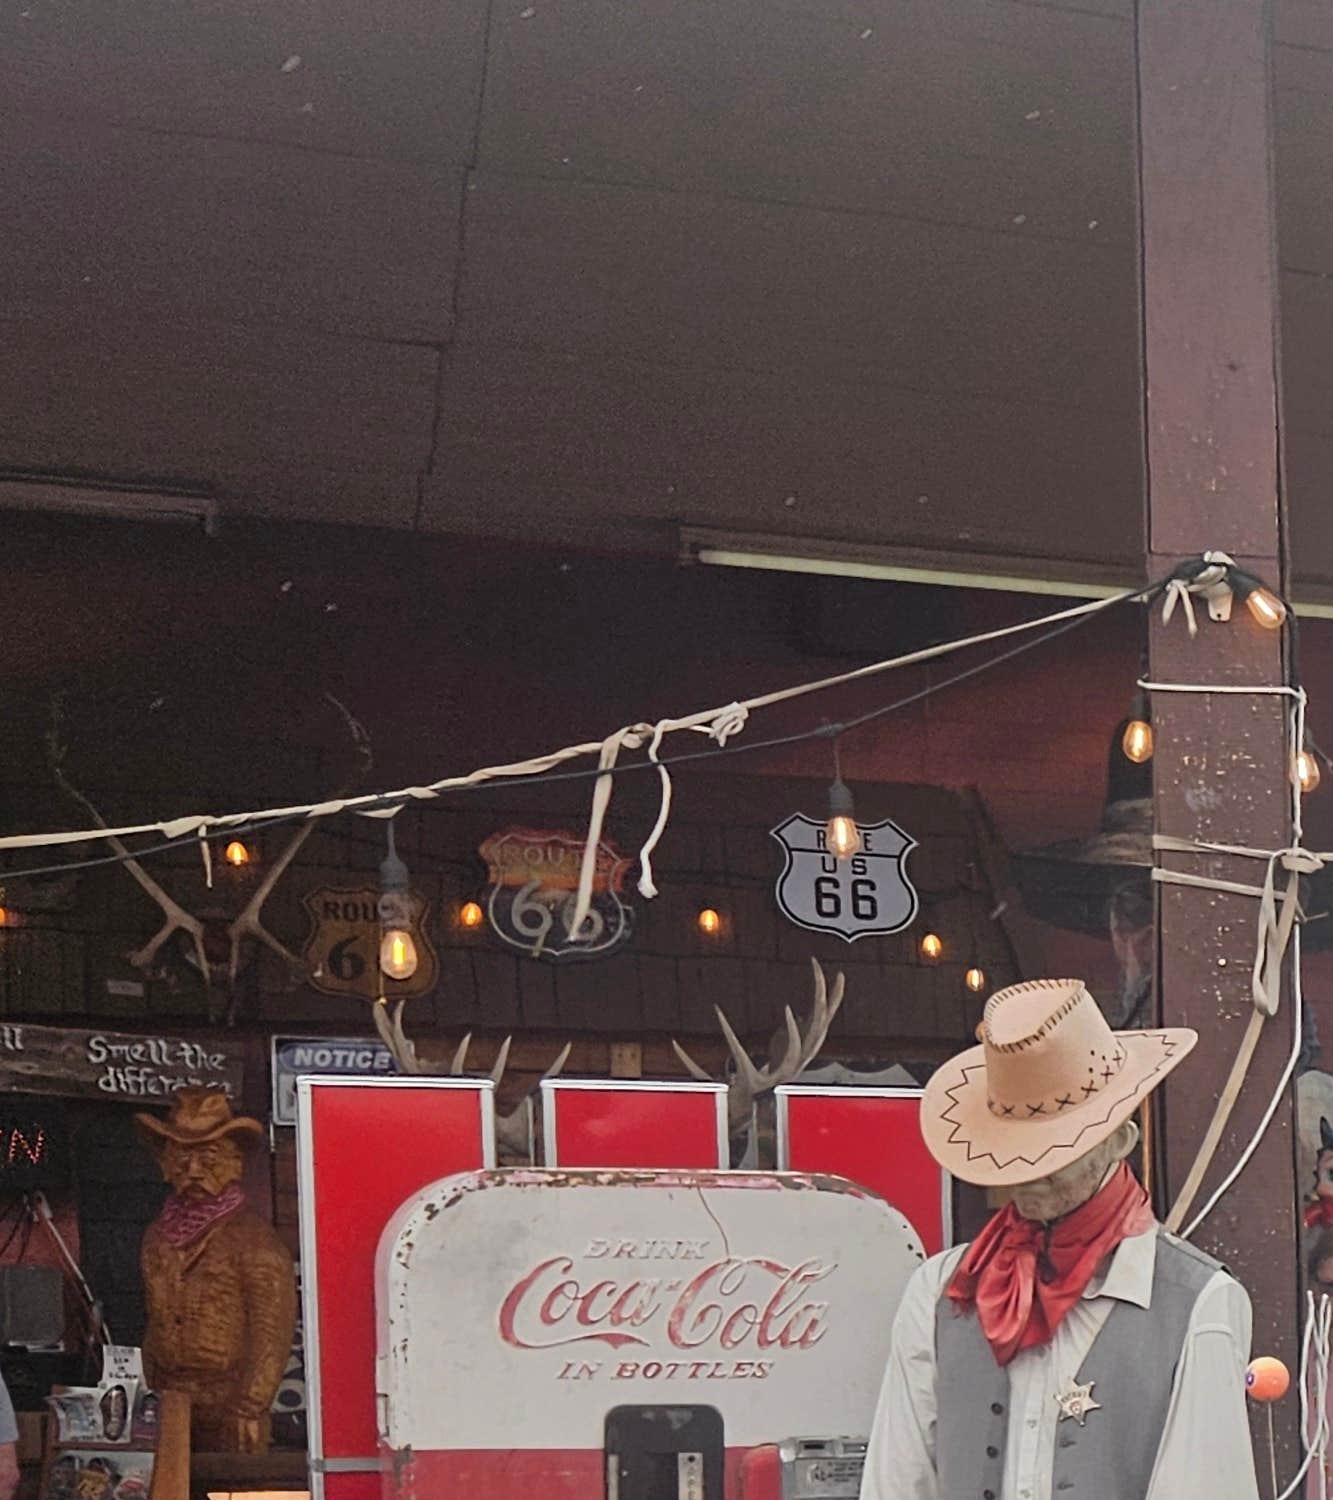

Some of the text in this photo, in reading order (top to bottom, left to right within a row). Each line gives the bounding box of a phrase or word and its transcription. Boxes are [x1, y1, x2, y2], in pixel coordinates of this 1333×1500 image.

[815, 876, 878, 920] 66
[87, 1036, 226, 1071] Smell the
[295, 1048, 392, 1069] NOTICE
[583, 1239, 711, 1260] DRINK
[499, 1256, 838, 1350] Coca-Cola
[557, 1361, 775, 1380] IN BOTTLES
